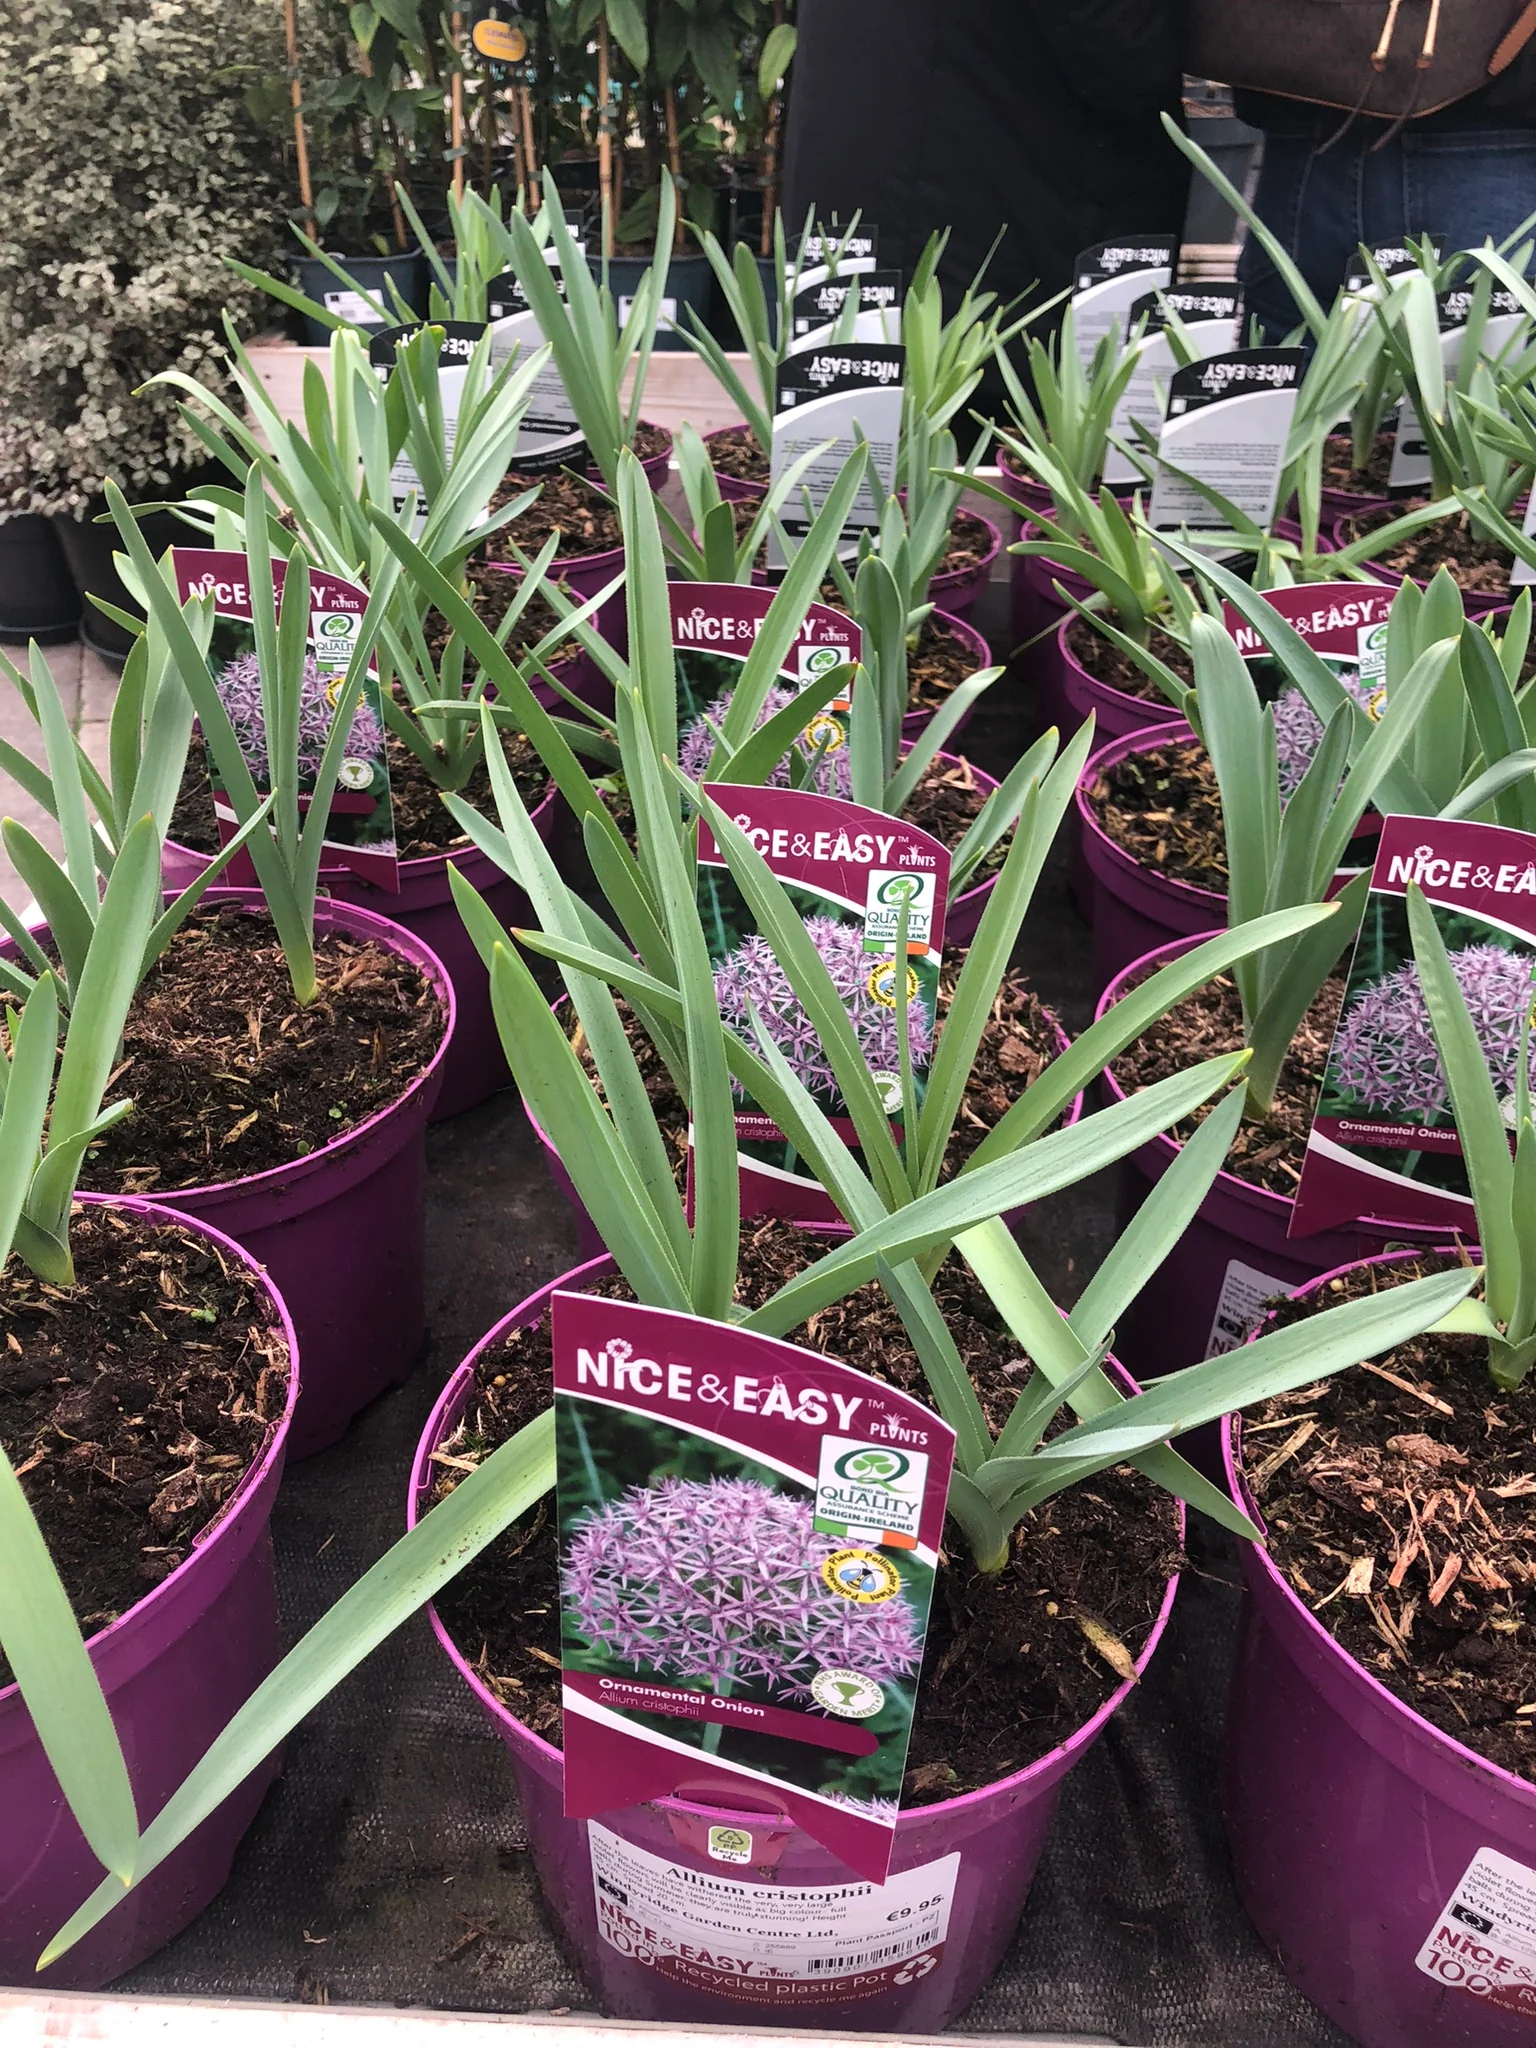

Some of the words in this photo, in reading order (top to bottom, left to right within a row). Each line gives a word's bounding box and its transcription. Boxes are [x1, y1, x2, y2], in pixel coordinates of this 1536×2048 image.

[811, 356, 899, 383] NICE&EASY
[1204, 363, 1296, 385] NICE&EASY
[331, 594, 359, 609] PLANTS
[316, 641, 355, 651] QUALIT
[819, 630, 849, 642] PLANTS
[714, 828, 895, 865] CE&EASY
[899, 849, 936, 867] PLANTS
[868, 911, 930, 926] QUAITY
[873, 964, 890, 979] Plant
[1338, 1120, 1415, 1136] Ornamental
[1418, 1128, 1457, 1141] Onion
[577, 1341, 862, 1432] NICE&EASY
[870, 1417, 928, 1446] PLANTS
[820, 1486, 918, 1515] QUALITY
[850, 1485, 874, 1494] BORD
[820, 1507, 914, 1531] ORIGIN-IRELAND
[827, 1501, 874, 1515] ASSURANCE
[877, 1508, 910, 1521] SCHEME
[828, 1551, 855, 1566] Plant
[864, 1552, 896, 1588] Pollinator
[827, 1566, 859, 1602] Pollinator
[870, 1587, 896, 1601] Plant
[599, 1678, 706, 1706] Ornamental
[711, 1698, 765, 1718] Onion
[815, 1671, 832, 1687] RHS
[833, 1671, 874, 1688] AWARD
[871, 1686, 882, 1700] OF
[598, 1691, 639, 1707] Allium
[643, 1699, 701, 1718] cristophii
[813, 1690, 848, 1717] GARDEN
[851, 1702, 881, 1719] MERIT
[712, 1846, 748, 1858] Recycle
[722, 1854, 737, 1862] Me
[592, 1834, 612, 1851] After
[615, 1850, 629, 1861] the
[631, 1859, 659, 1877] leaves
[662, 1874, 684, 1887] have
[687, 1884, 731, 1901] withered
[734, 1895, 751, 1904] the
[807, 1901, 833, 1909] large
[593, 1842, 616, 1860] violet
[618, 1856, 649, 1879] flowers
[651, 1877, 668, 1888] will
[671, 1885, 683, 1893] be
[685, 1890, 717, 1905] clearly
[720, 1900, 752, 1911] visible
[769, 1906, 786, 1915] big
[667, 1867, 745, 1896] Allium
[753, 1884, 872, 1902] cristophii
[1472, 1869, 1502, 1888] violet
[1475, 1863, 1503, 1880] After
[1505, 1878, 1524, 1891] the
[596, 1862, 678, 1913] Windyridge
[682, 1911, 741, 1932] Garden
[746, 1927, 801, 1938] Centre
[807, 1929, 839, 1938] Ltd.
[614, 1861, 643, 1883] during
[689, 1898, 712, 1910] they
[714, 1905, 730, 1914] are
[812, 1913, 847, 1922] Height
[623, 1872, 653, 1894] Spread
[656, 1892, 668, 1901] 20
[670, 1898, 684, 1907] cm
[1464, 1882, 1478, 1893] 45
[1468, 1876, 1493, 1892] balls
[1495, 1890, 1531, 1912] during
[886, 1894, 942, 1922] €9.95
[600, 1895, 754, 1975] NICE&EASY
[835, 1936, 863, 1947] Plant
[866, 1923, 913, 1942] Passport
[760, 1965, 794, 1978] PLANTS
[1432, 1939, 1483, 1971] Potted
[1485, 1967, 1500, 1981] in
[656, 1966, 680, 1982] Help
[681, 1978, 699, 1988] the
[702, 1986, 770, 2004] environment
[797, 1997, 836, 2005] recycle
[839, 1994, 856, 2002] me
[858, 1986, 888, 2000] again
[675, 1959, 768, 1992] Recycled
[776, 1980, 847, 1995] plastic
[853, 1971, 888, 1988] Pot
[1488, 1994, 1515, 2010] Help
